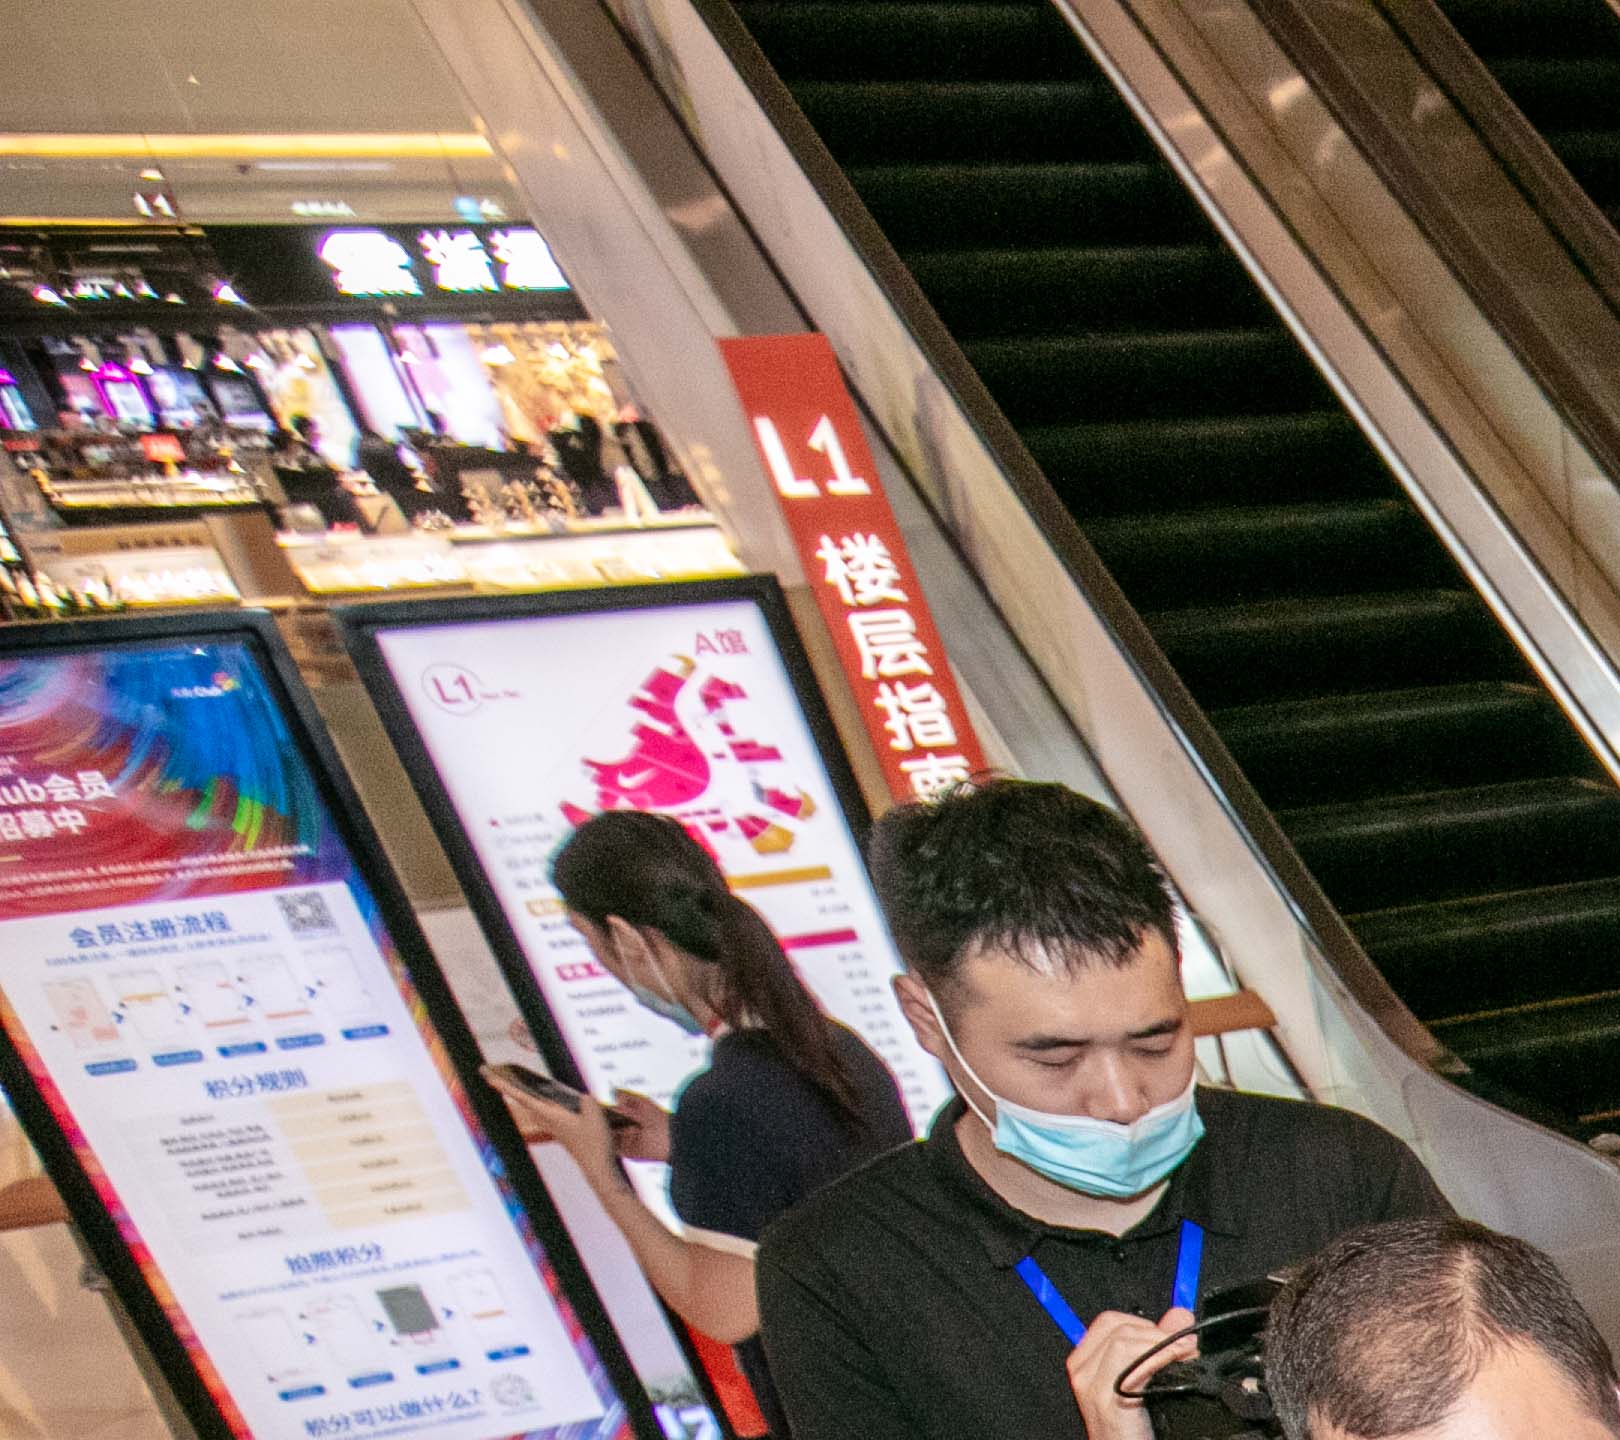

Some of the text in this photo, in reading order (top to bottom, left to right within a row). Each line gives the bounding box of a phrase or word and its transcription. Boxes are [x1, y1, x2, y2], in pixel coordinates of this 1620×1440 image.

[753, 412, 871, 499] L1
[695, 629, 751, 656] A馆
[432, 674, 474, 704] L1
[69, 911, 232, 948] 会员注册流程
[203, 1069, 309, 1100] 积分规则
